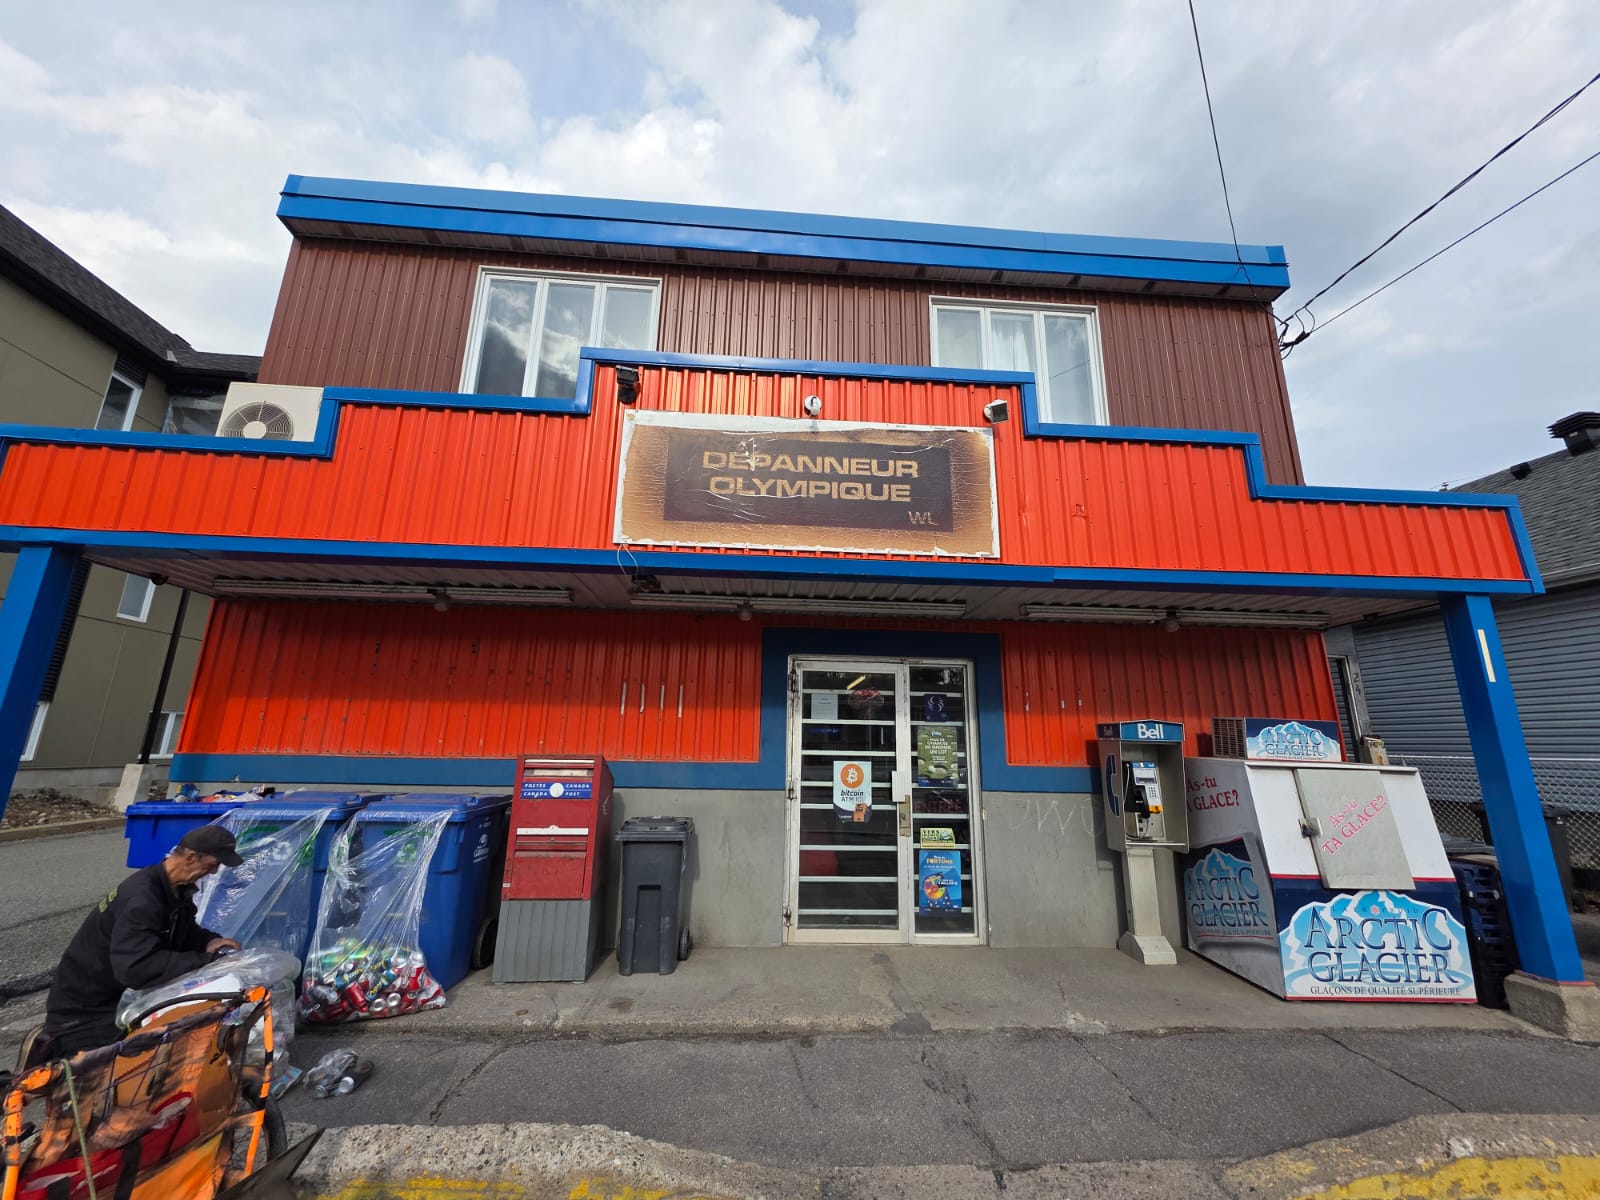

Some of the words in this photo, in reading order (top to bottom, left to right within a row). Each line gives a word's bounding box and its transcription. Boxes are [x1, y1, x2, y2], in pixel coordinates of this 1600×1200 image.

[709, 476, 911, 502] OLYMPIQUE
[1137, 723, 1164, 739] Bell
[1264, 728, 1322, 745] ARCTIC
[1265, 743, 1325, 757] GLACIER
[840, 789, 864, 797] bitcoin
[1193, 788, 1240, 811] GLACE?
[1321, 837, 1343, 854] TA
[1341, 794, 1387, 838] GLACE?
[1186, 866, 1259, 901] ARCTIC
[1191, 901, 1269, 927] GLACIER
[1304, 906, 1452, 951] ARCTIC
[1307, 951, 1458, 984] GLACIER
[1310, 985, 1350, 996] GLAÇONS
[1350, 986, 1365, 995] DE
[1368, 985, 1406, 996] QUALITÉ
[1407, 985, 1461, 996] SUPÉRIEURE
